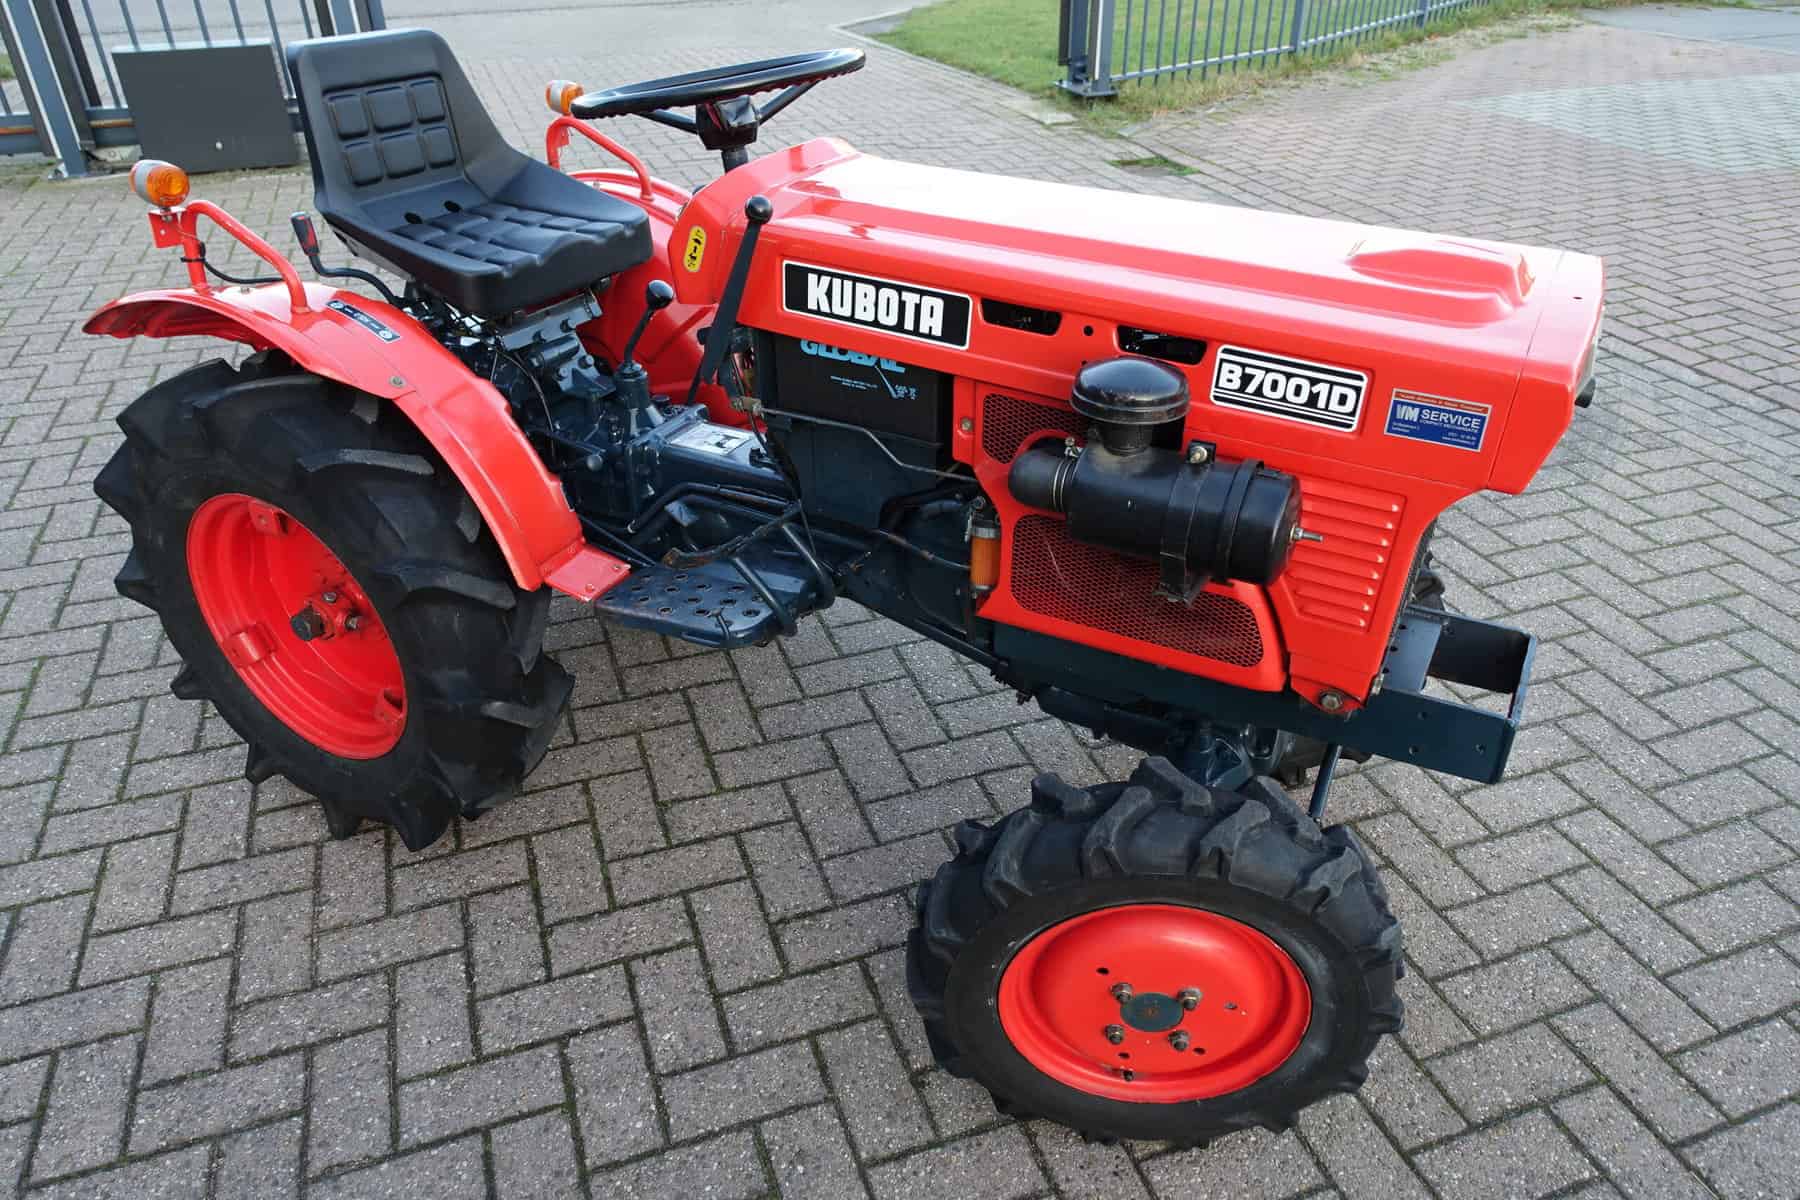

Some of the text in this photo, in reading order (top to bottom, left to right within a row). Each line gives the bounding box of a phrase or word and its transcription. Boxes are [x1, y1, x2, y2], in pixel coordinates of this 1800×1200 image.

[807, 272, 945, 337] KUBOTA
[1217, 362, 1358, 414] B7001D
[1420, 409, 1482, 430] SERVICE
